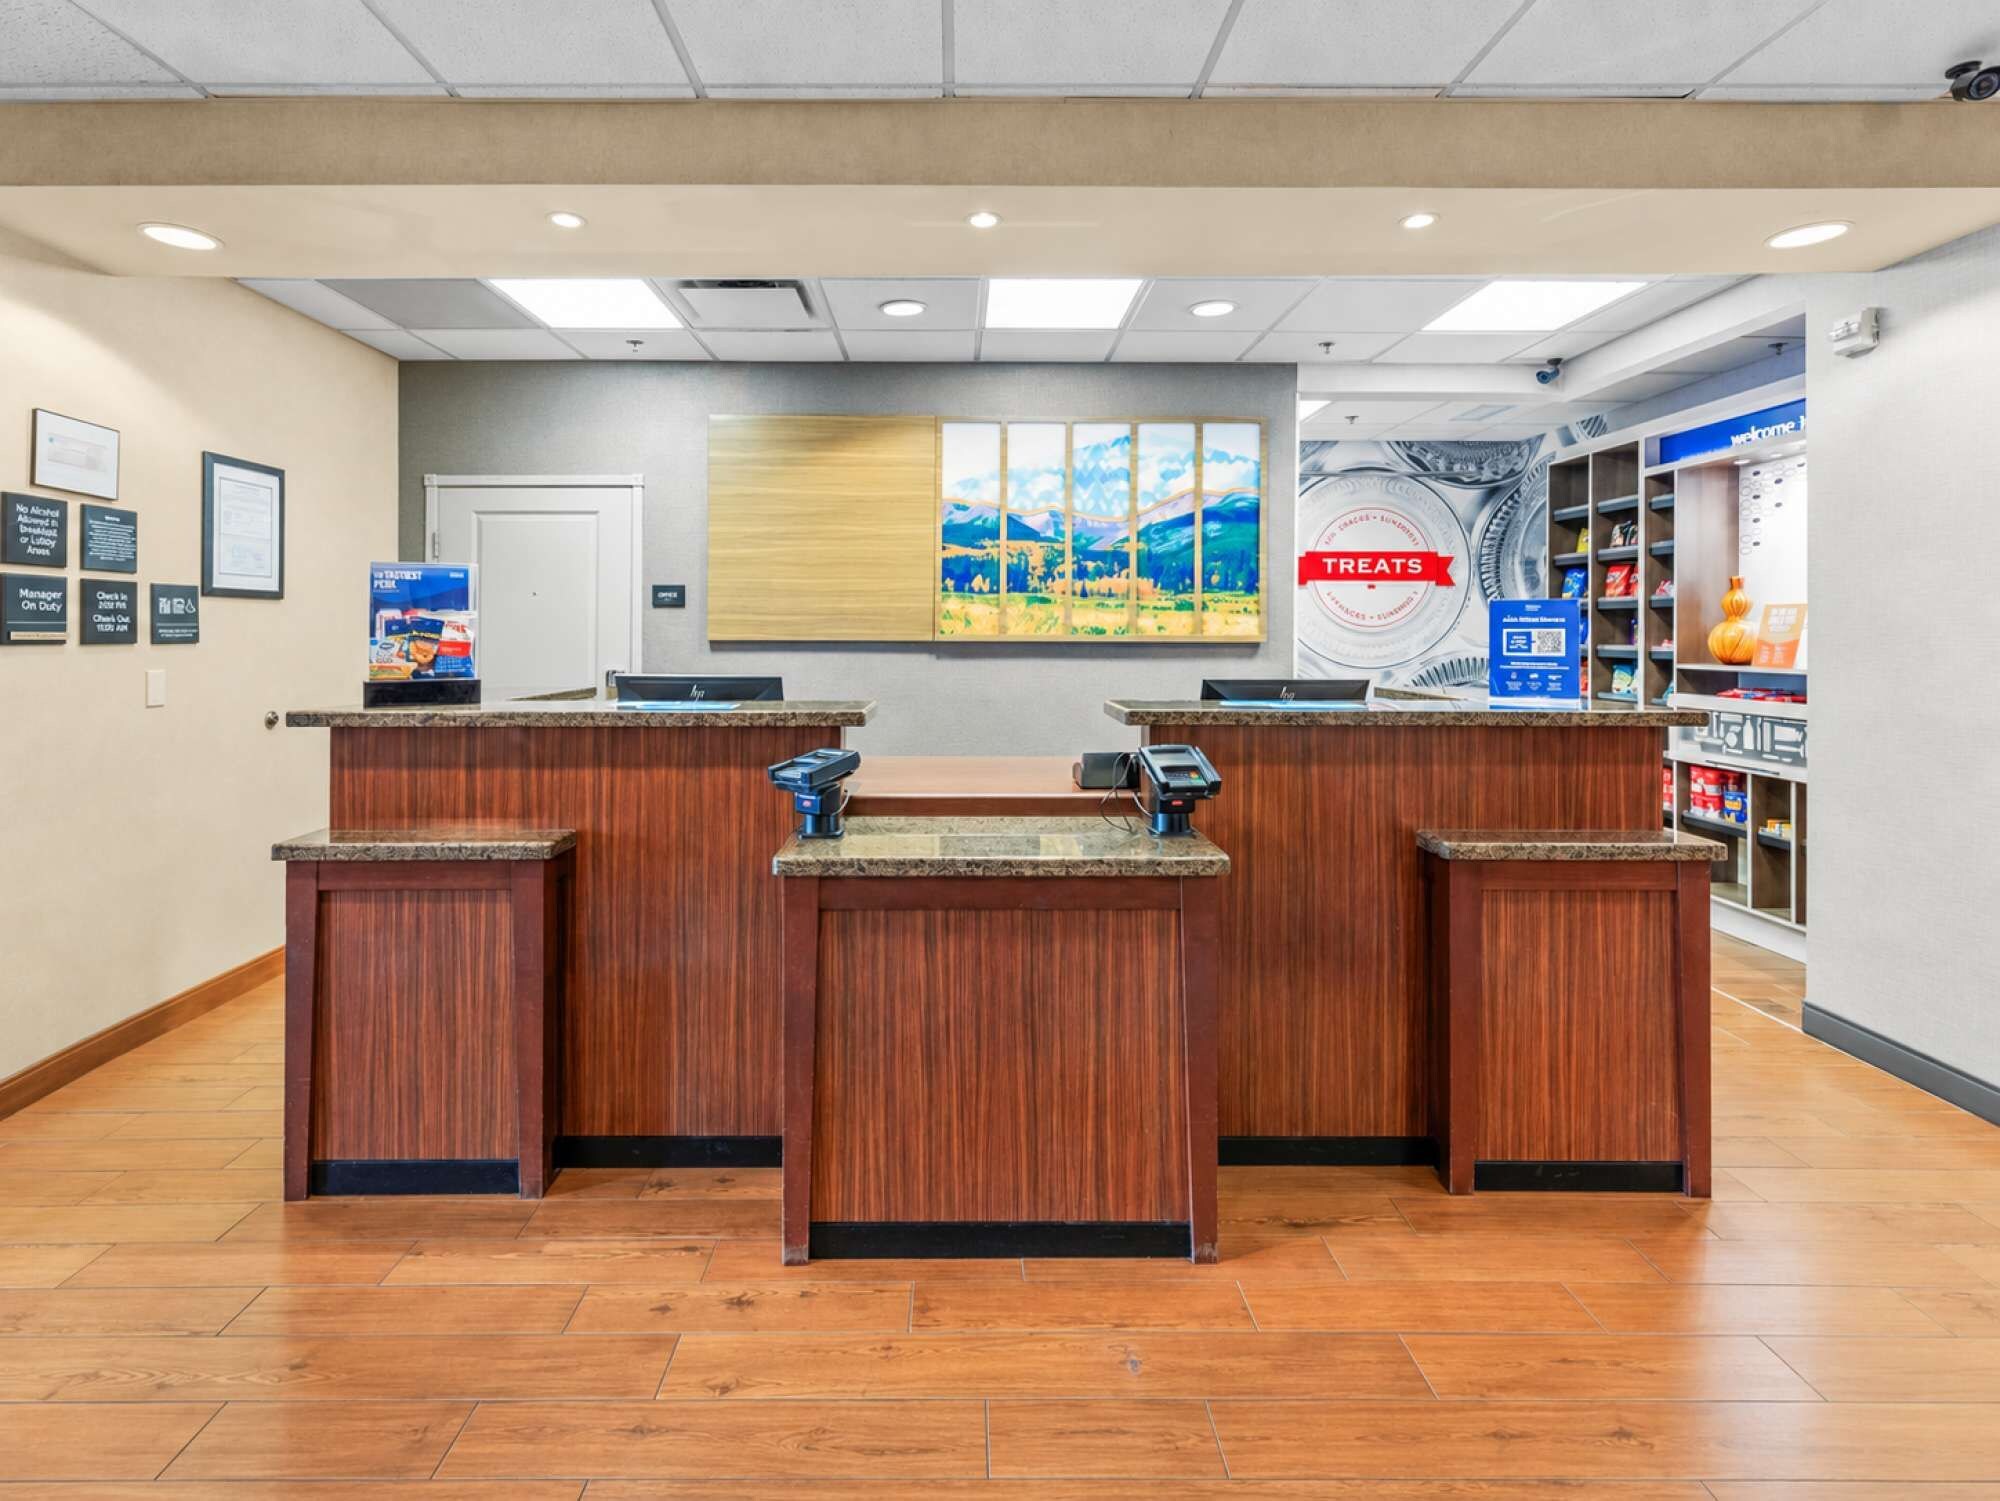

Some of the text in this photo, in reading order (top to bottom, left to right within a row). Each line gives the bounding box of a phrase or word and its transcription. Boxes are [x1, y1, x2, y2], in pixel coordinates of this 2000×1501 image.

[1730, 420, 1796, 447] welcome
[16, 503, 29, 514] No
[1322, 558, 1423, 574] TREATS
[19, 588, 63, 601] Manager
[21, 600, 63, 614] On Duty
[690, 683, 704, 701] hp
